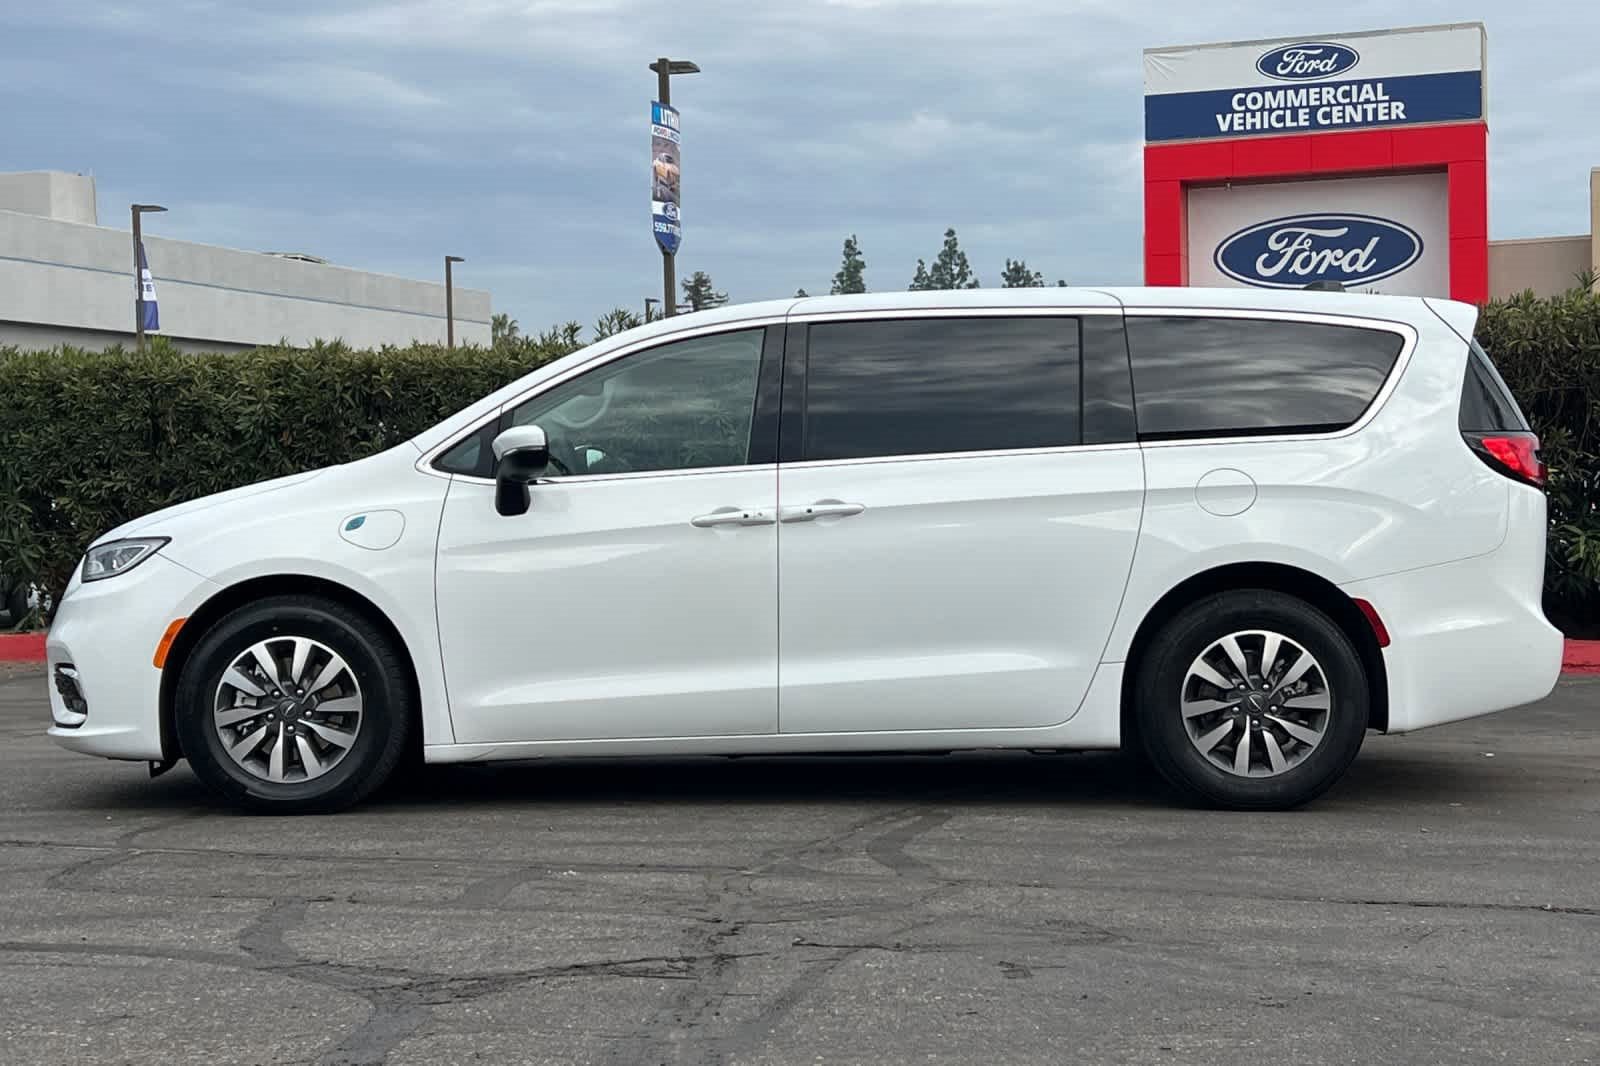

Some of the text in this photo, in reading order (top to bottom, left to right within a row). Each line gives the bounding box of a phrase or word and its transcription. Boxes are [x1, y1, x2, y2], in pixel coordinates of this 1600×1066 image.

[1276, 48, 1339, 75] Ford
[1231, 83, 1390, 112] COMMERCIAL
[1216, 101, 1407, 132] VEHICLE CENTER
[1255, 227, 1381, 277] Ford
